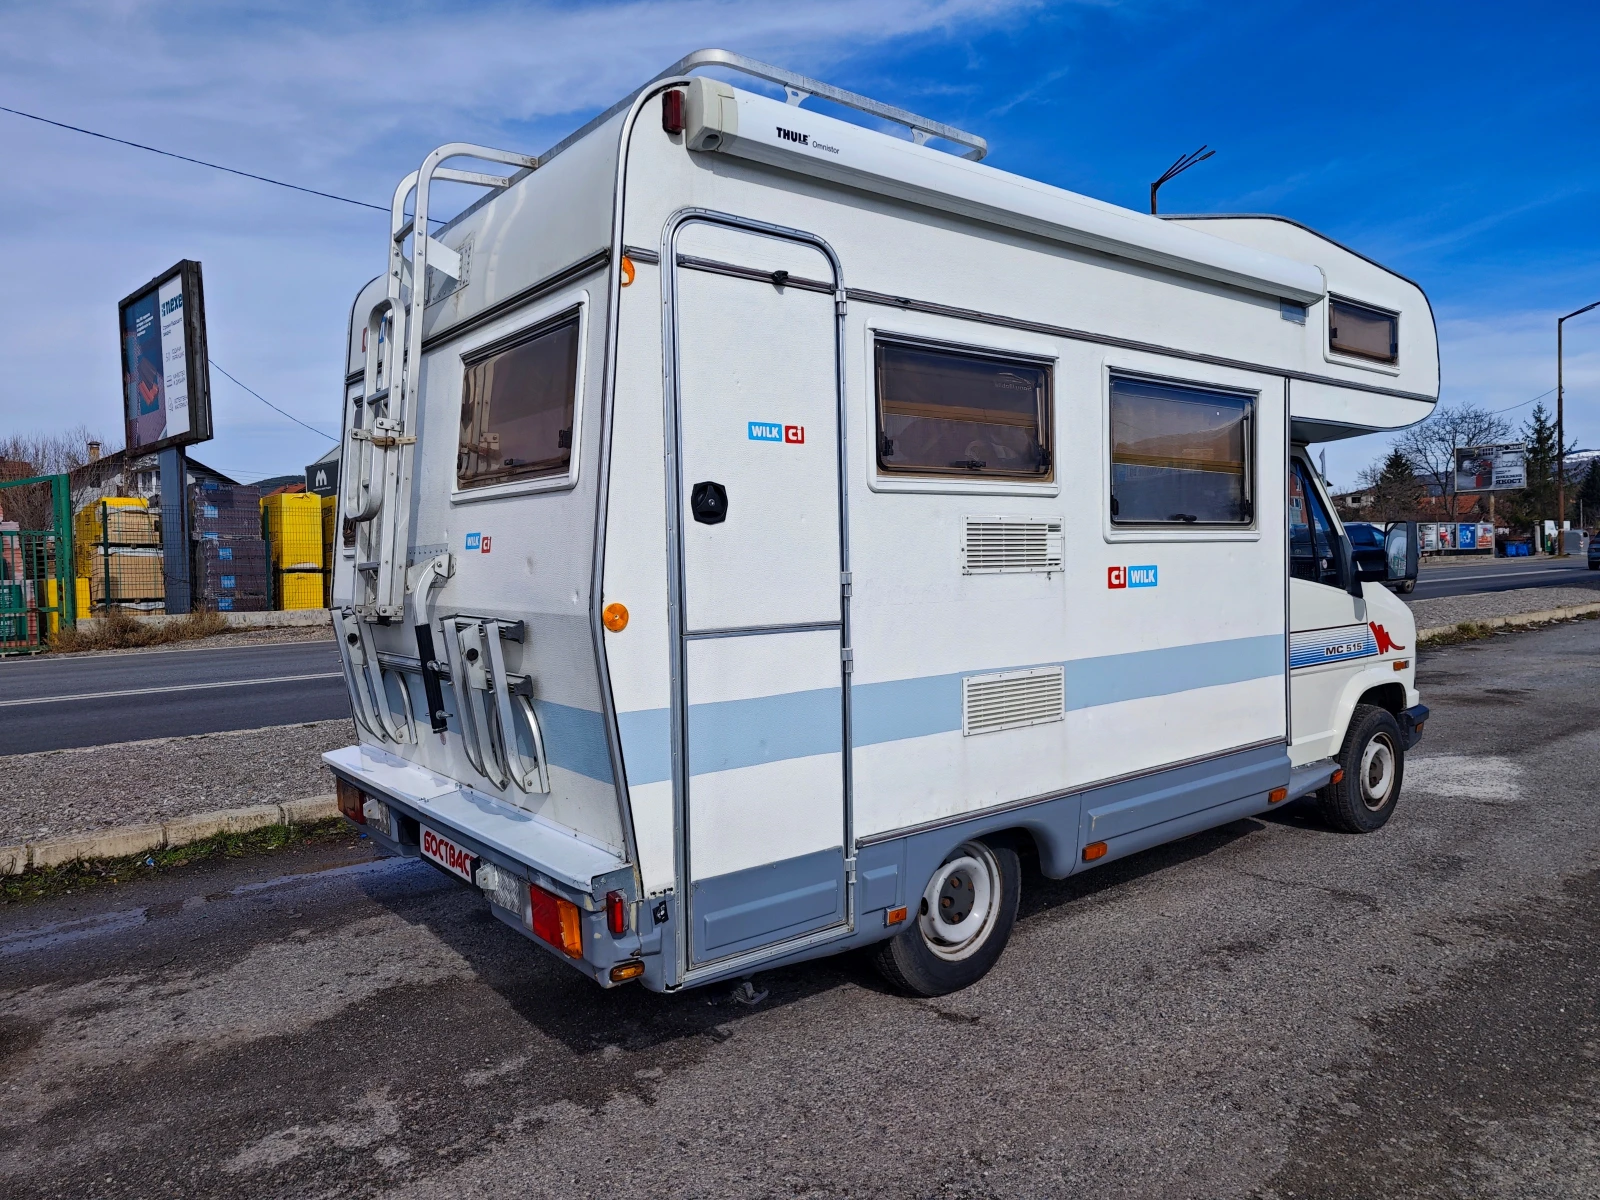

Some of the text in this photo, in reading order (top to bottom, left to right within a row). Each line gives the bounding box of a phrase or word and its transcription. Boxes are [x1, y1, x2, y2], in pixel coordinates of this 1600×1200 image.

[776, 126, 840, 154] THULE Omnistor
[751, 425, 780, 439] WILK
[1130, 569, 1156, 584] WILK
[1325, 642, 1363, 656] MC 515
[424, 830, 474, 877] БОСТВАС
